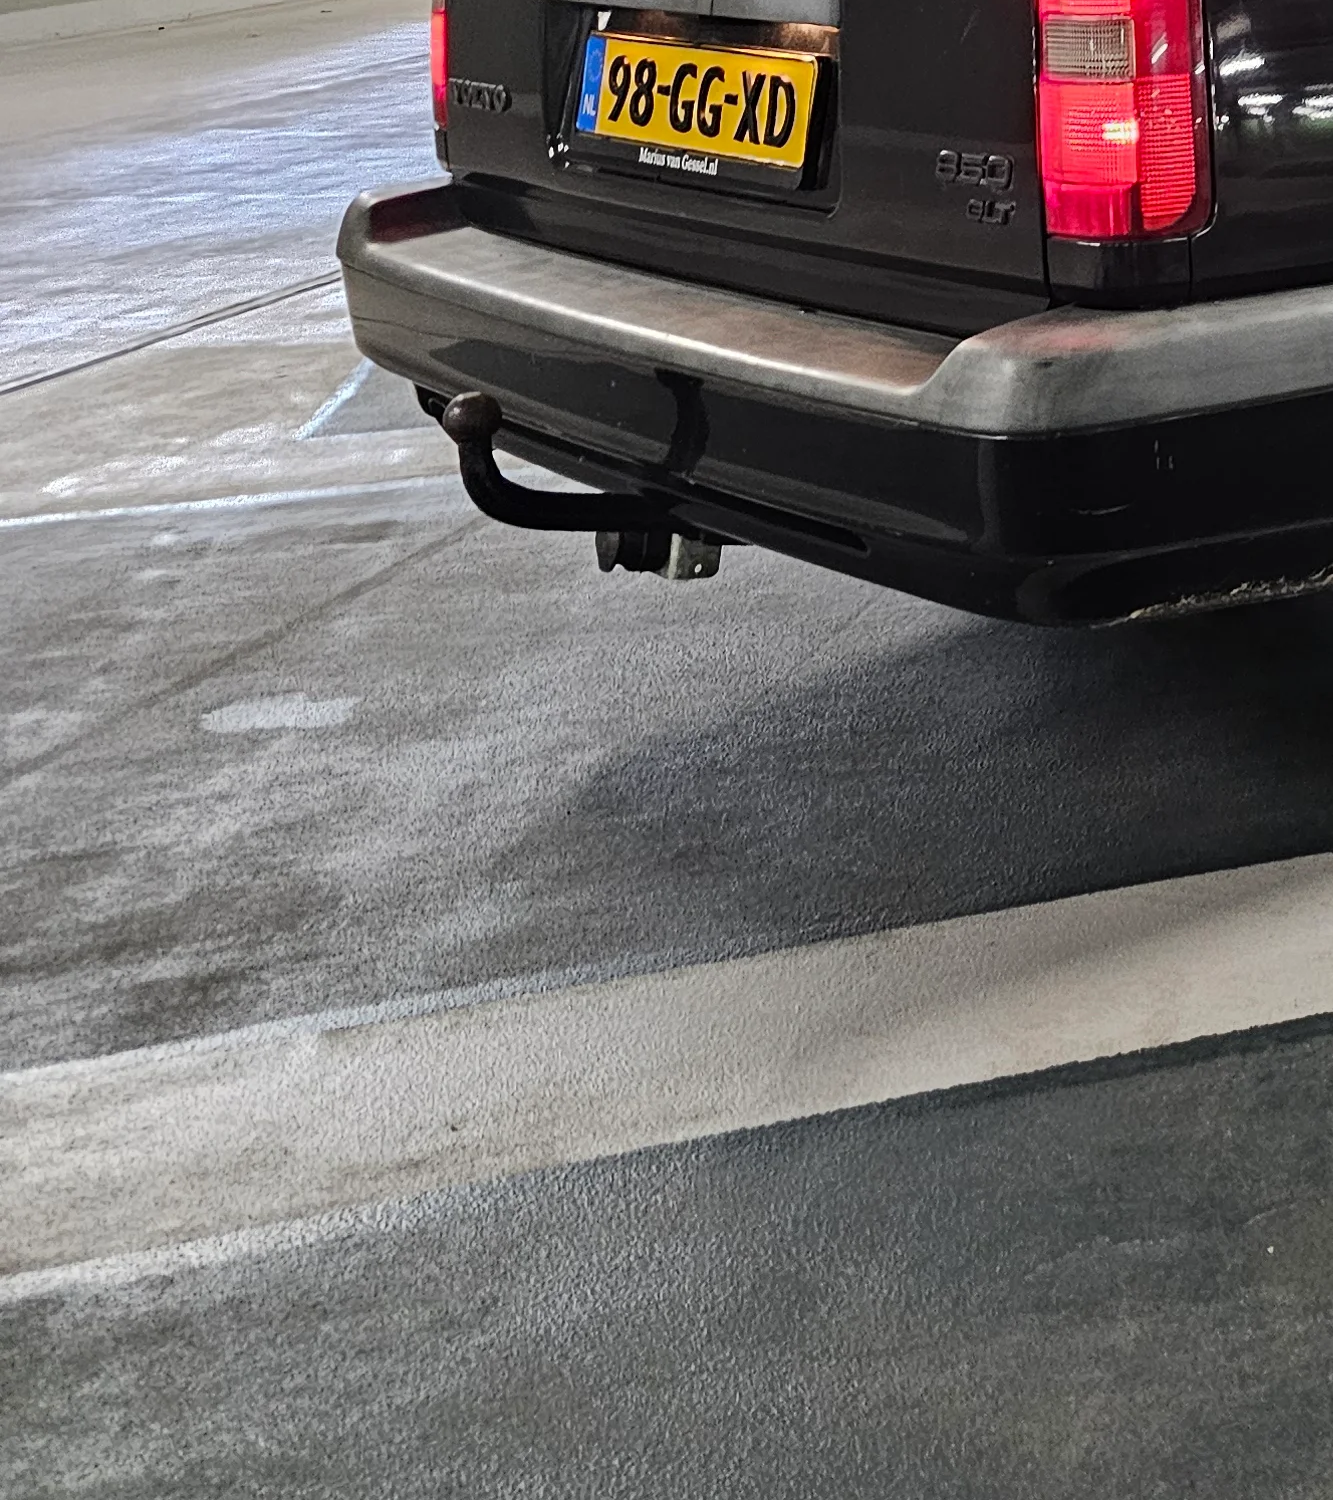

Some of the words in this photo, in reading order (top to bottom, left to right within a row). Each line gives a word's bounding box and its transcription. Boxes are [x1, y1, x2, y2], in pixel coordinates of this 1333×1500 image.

[582, 93, 596, 117] NL
[607, 54, 797, 149] 98-GG-XD
[638, 146, 666, 168] Marius
[666, 153, 682, 171] van
[681, 153, 718, 177] Gessel.nl
[935, 149, 1012, 188] 850
